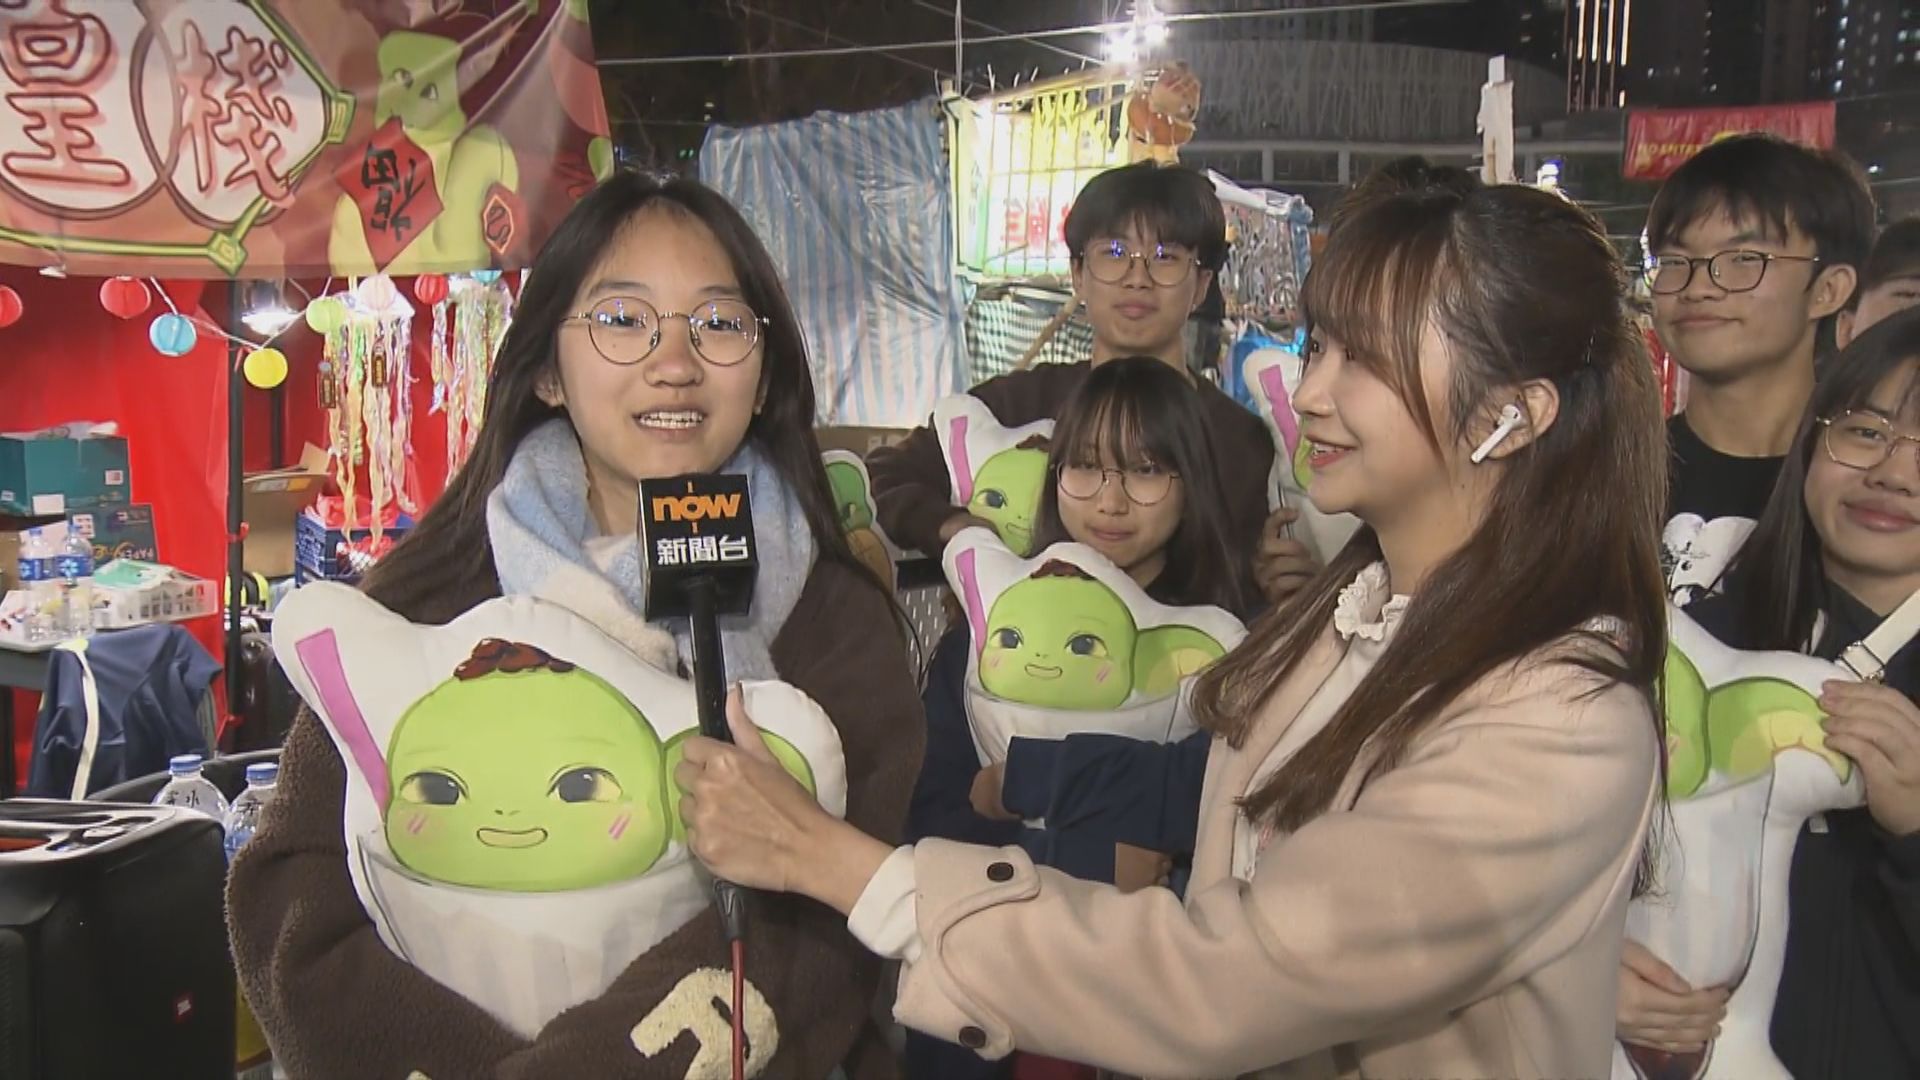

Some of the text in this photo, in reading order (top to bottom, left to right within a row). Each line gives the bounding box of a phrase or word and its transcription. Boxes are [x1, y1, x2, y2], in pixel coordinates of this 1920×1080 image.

[652, 494, 741, 521] now
[656, 534, 749, 566] 新聞台
